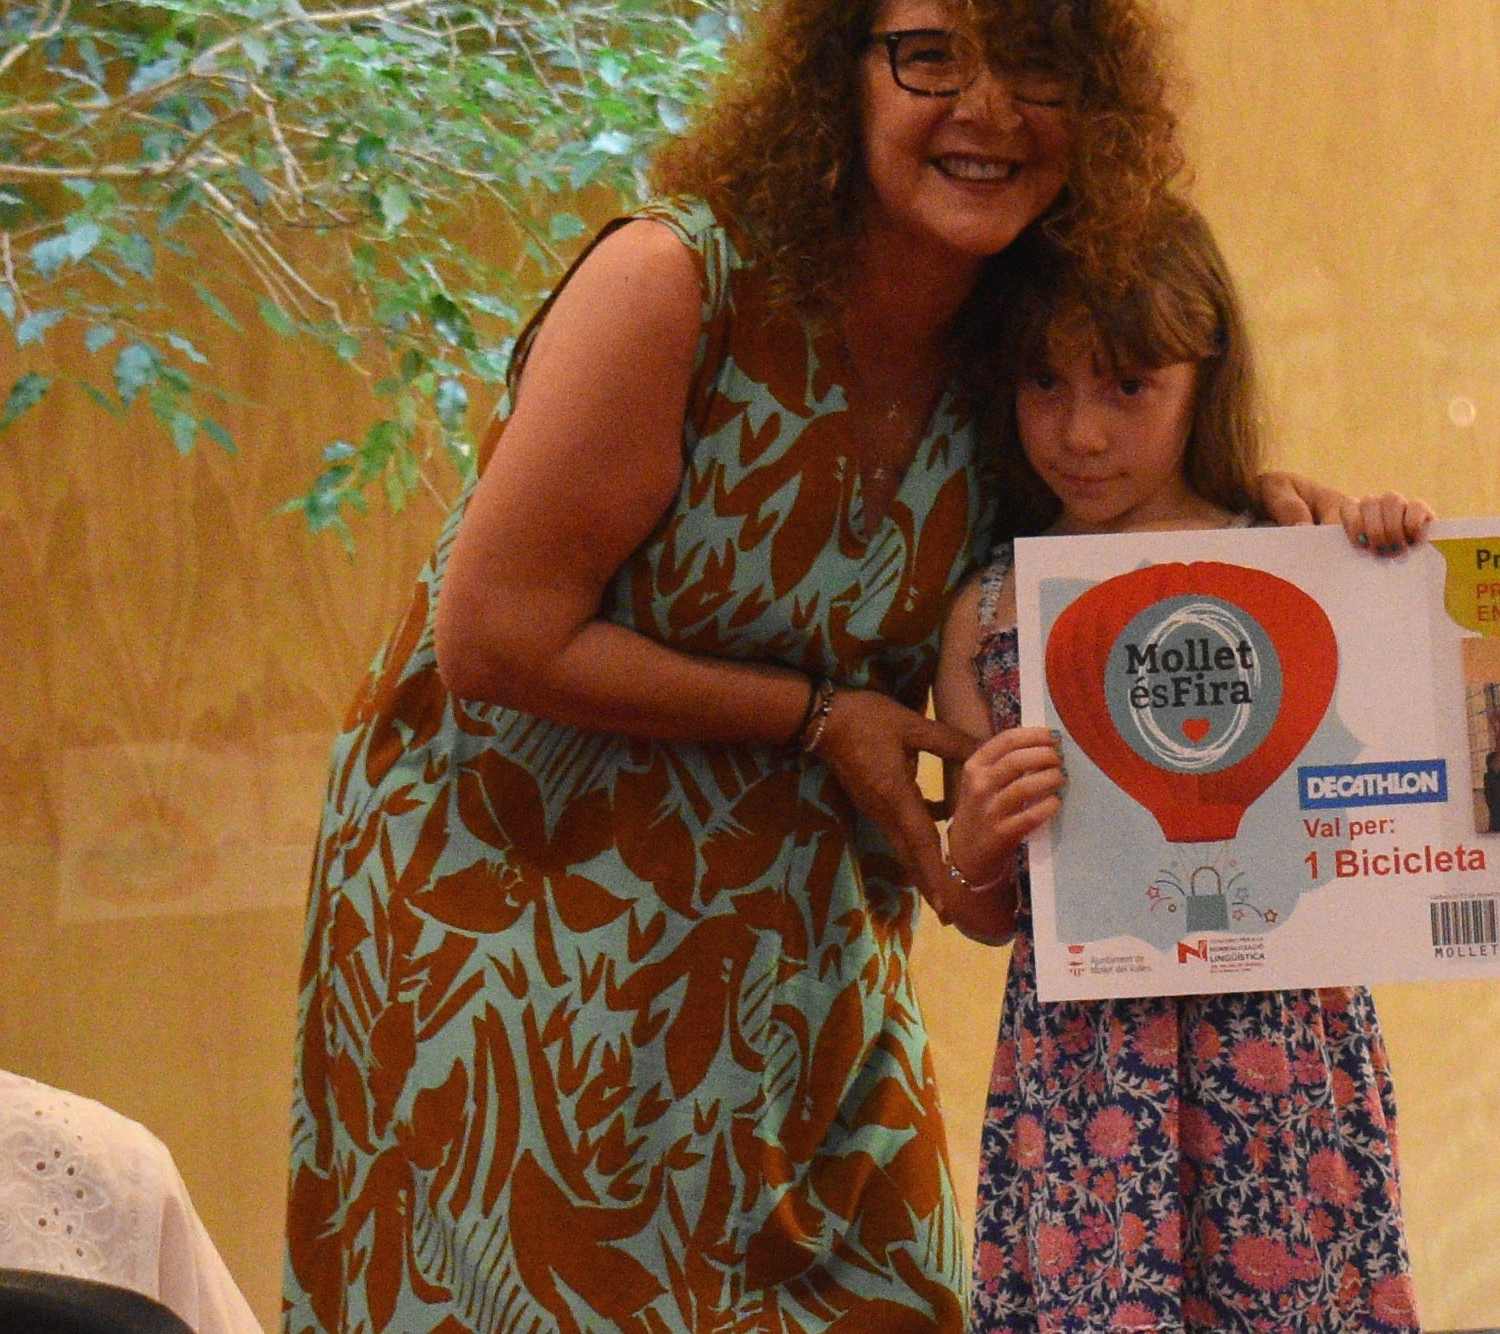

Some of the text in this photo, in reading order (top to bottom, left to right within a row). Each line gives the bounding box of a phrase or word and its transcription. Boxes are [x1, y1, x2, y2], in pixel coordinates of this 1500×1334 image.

[1125, 637, 1254, 675] Mollet
[1307, 770, 1440, 801] DECATHLON
[1303, 817, 1396, 841] Val per:
[1304, 843, 1487, 880] 1 Bicicleta
[1434, 944, 1499, 959] MOLLET
